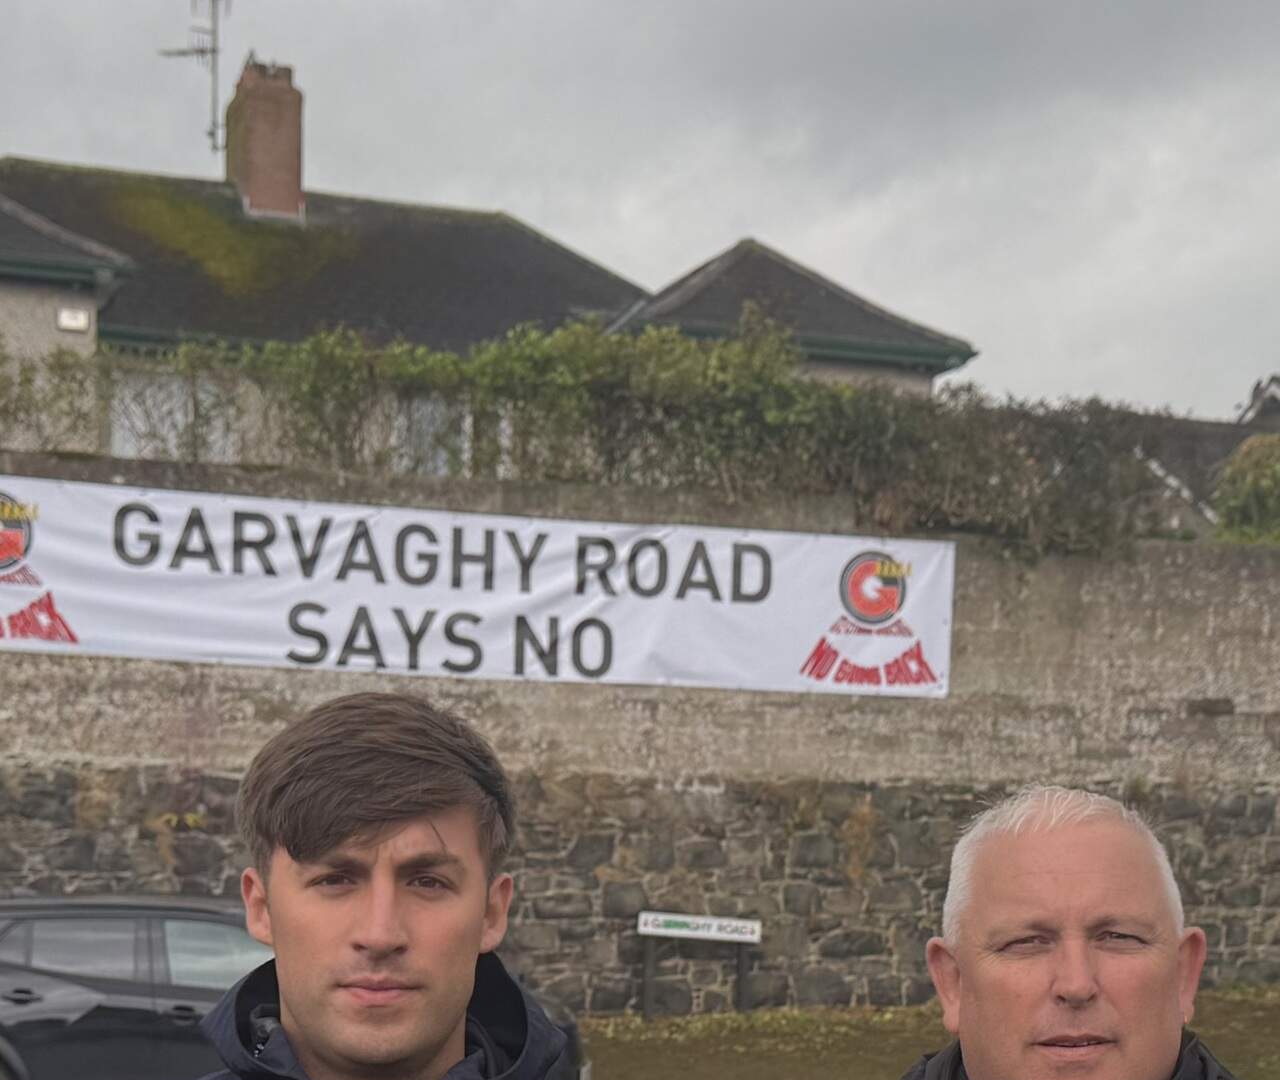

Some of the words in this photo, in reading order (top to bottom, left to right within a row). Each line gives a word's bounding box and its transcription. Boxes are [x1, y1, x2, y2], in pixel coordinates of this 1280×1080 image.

[113, 503, 547, 593] GARVAGHY
[574, 534, 772, 603] ROAD
[286, 601, 483, 673] SAYS
[513, 614, 613, 678] NO
[800, 637, 839, 681] NO
